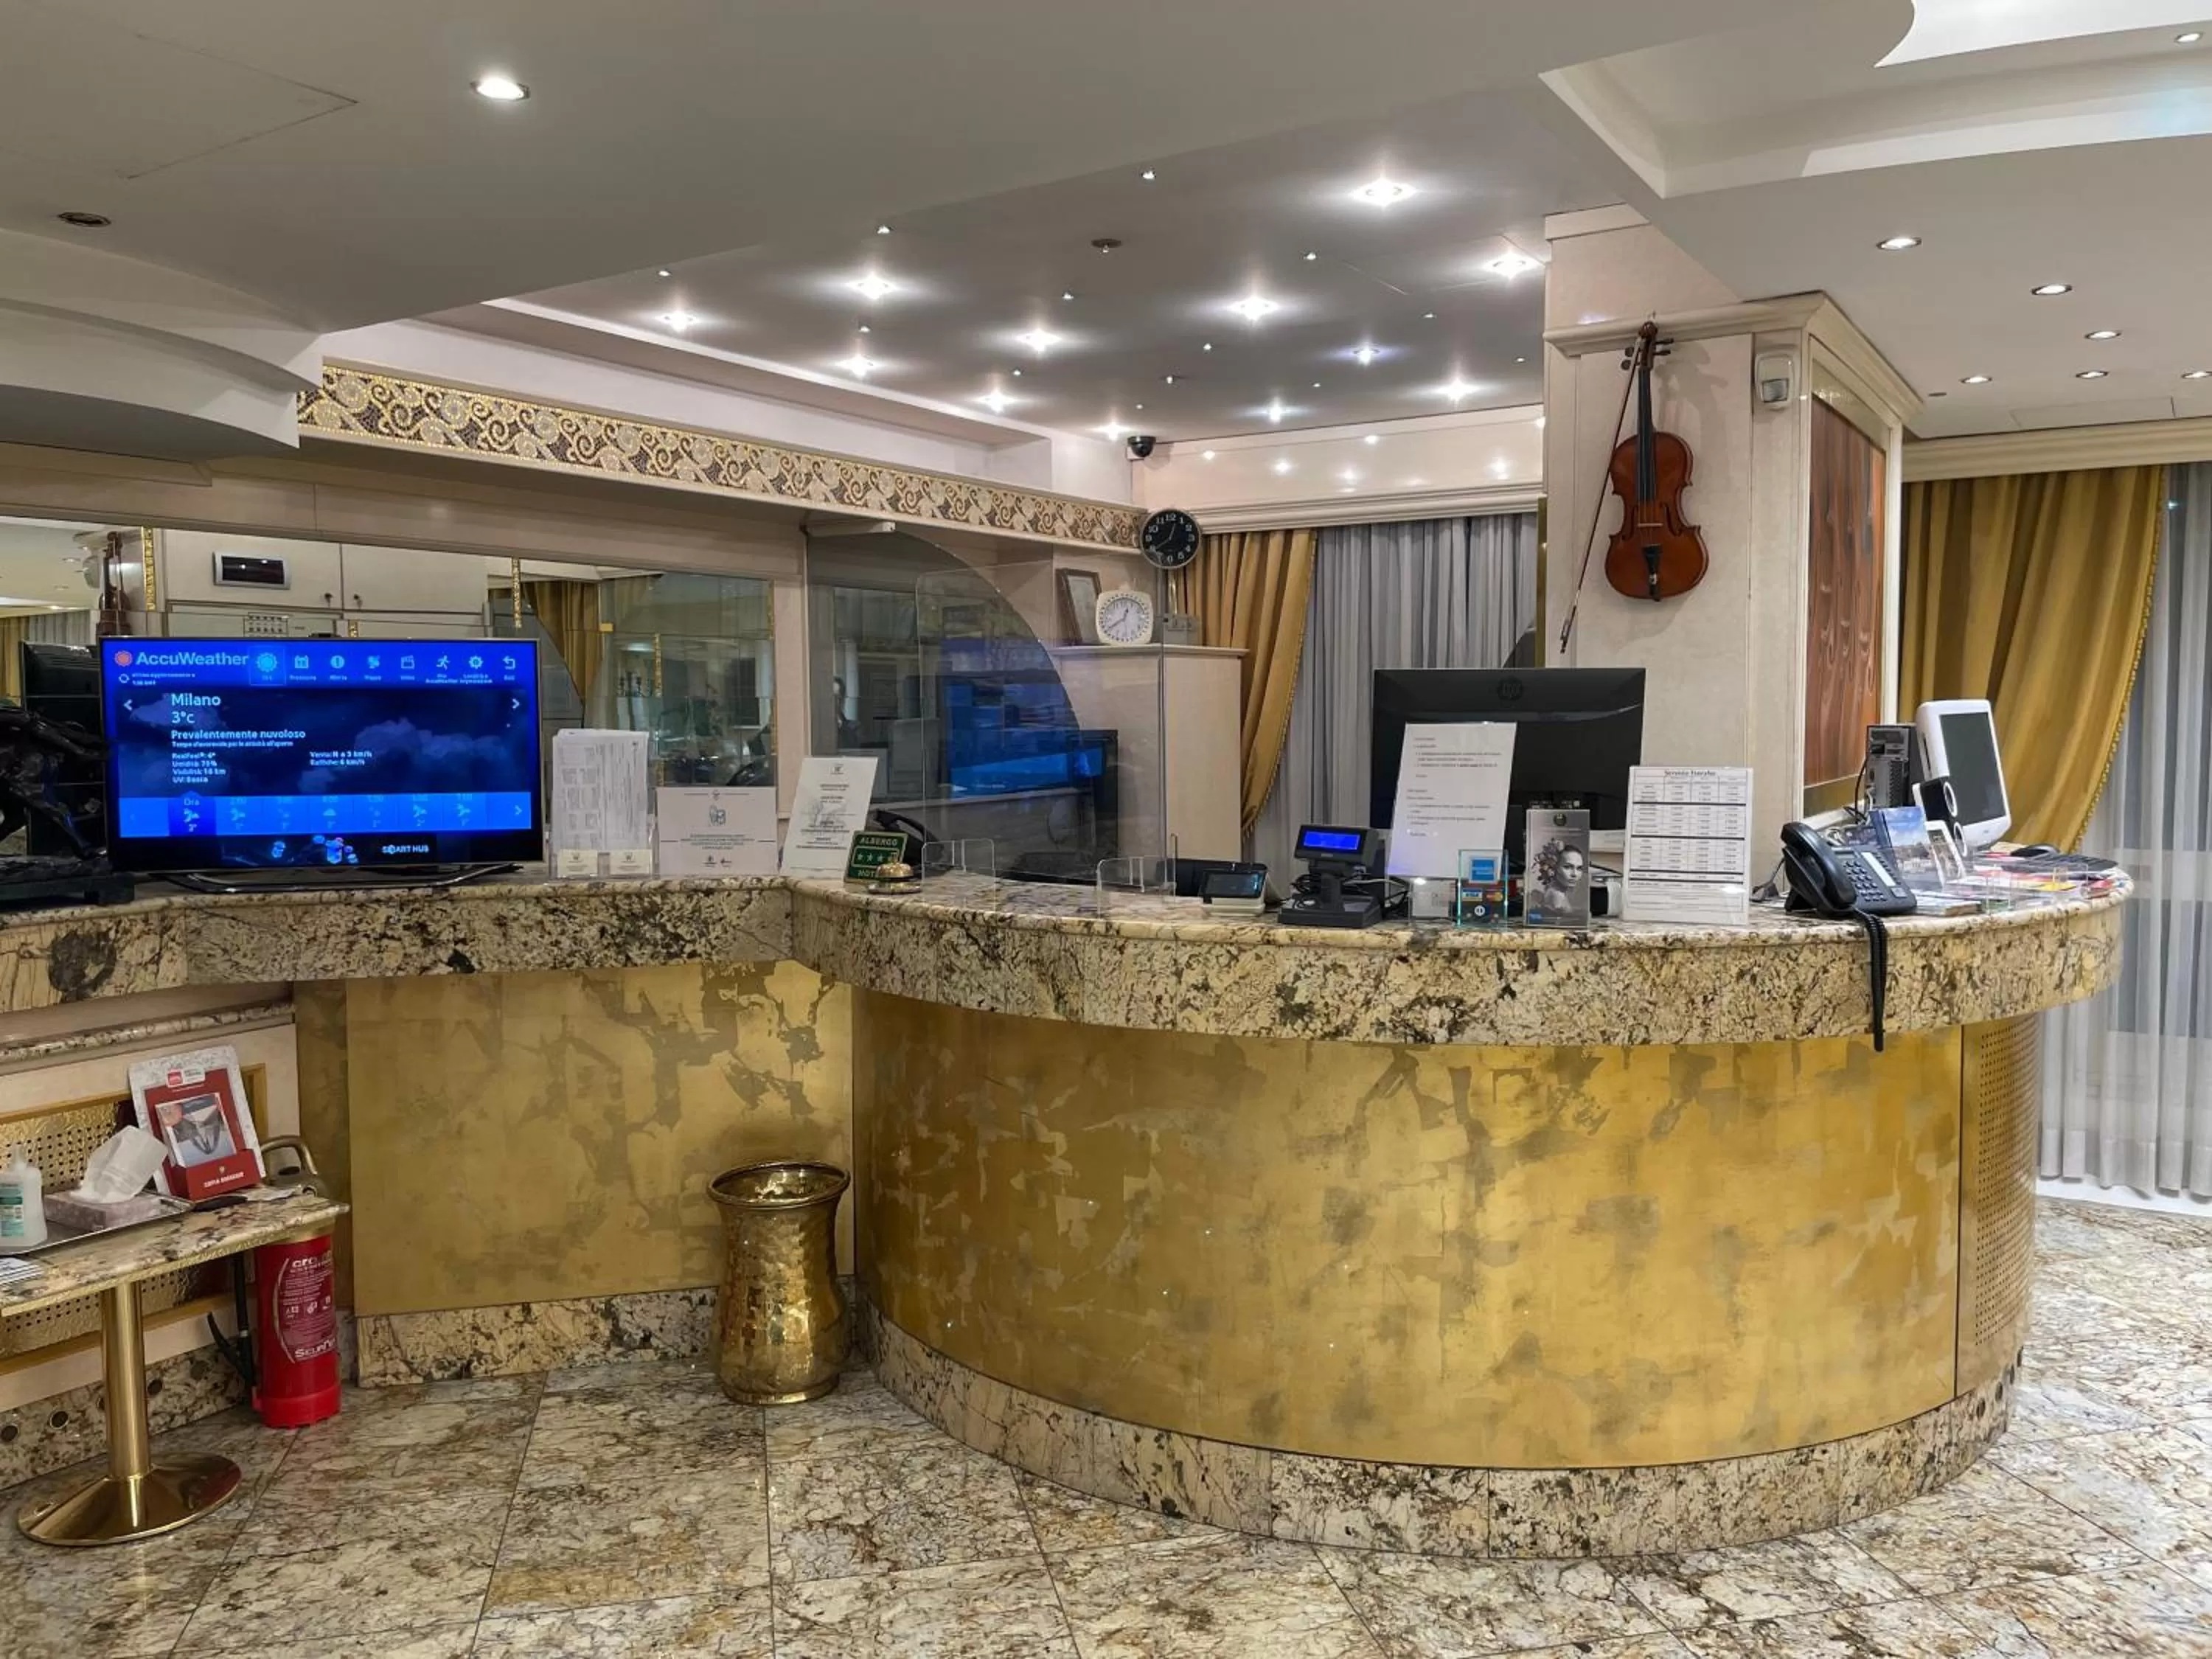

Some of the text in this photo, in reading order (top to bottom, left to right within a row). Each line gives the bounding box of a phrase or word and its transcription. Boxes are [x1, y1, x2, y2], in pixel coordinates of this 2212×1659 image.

[136, 651, 248, 666] AccuWeather
[170, 693, 221, 706] Milano
[171, 729, 306, 740] Prevalentemente nuvoloso
[859, 837, 898, 846] ALBERGO
